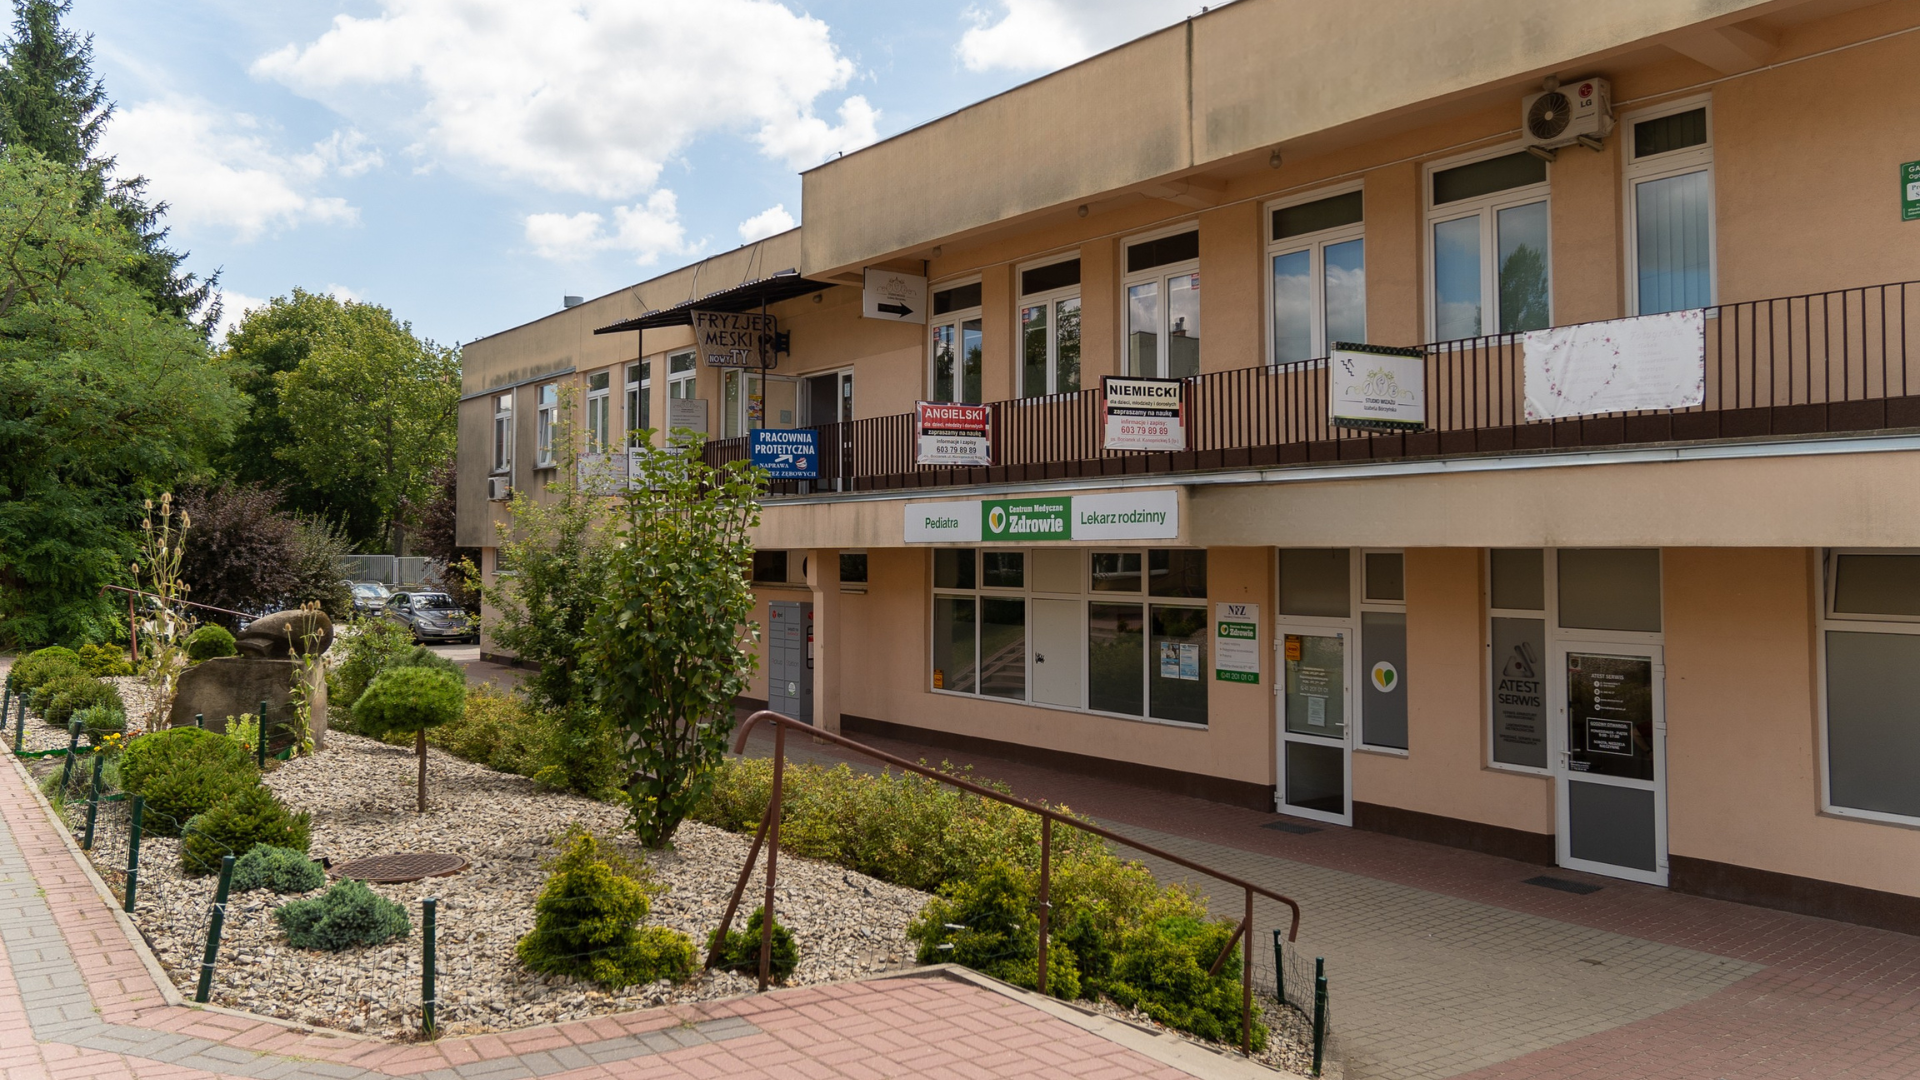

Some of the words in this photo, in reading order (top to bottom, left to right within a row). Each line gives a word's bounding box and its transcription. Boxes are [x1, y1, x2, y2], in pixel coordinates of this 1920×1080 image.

[1581, 99, 1592, 108] LG
[697, 313, 772, 331] FRYZJER
[1109, 385, 1177, 397] NIEMIECKI
[925, 408, 983, 420] ANGIELSKI
[1113, 409, 1147, 417] zapraszamy
[1121, 426, 1135, 434] 603
[1148, 427, 1157, 435] 89
[1158, 427, 1168, 435] 89
[760, 432, 812, 443] PRACOWNIA
[755, 444, 815, 455] PROTETYCZNA
[960, 446, 968, 454] 89
[969, 446, 977, 454] 89
[1009, 505, 1033, 513] Centrum
[1033, 504, 1063, 513] Medyczne
[925, 517, 959, 529] Pediatra
[1080, 511, 1116, 525] Lekarz
[1118, 509, 1167, 526] rodzinny
[1009, 515, 1064, 533] Zdrowie
[1228, 605, 1246, 616] NFZ
[1229, 628, 1254, 637] Zdrowie
[1231, 672, 1240, 680] 201
[1498, 679, 1540, 693] ATEST
[1498, 693, 1541, 707] SERWIS
